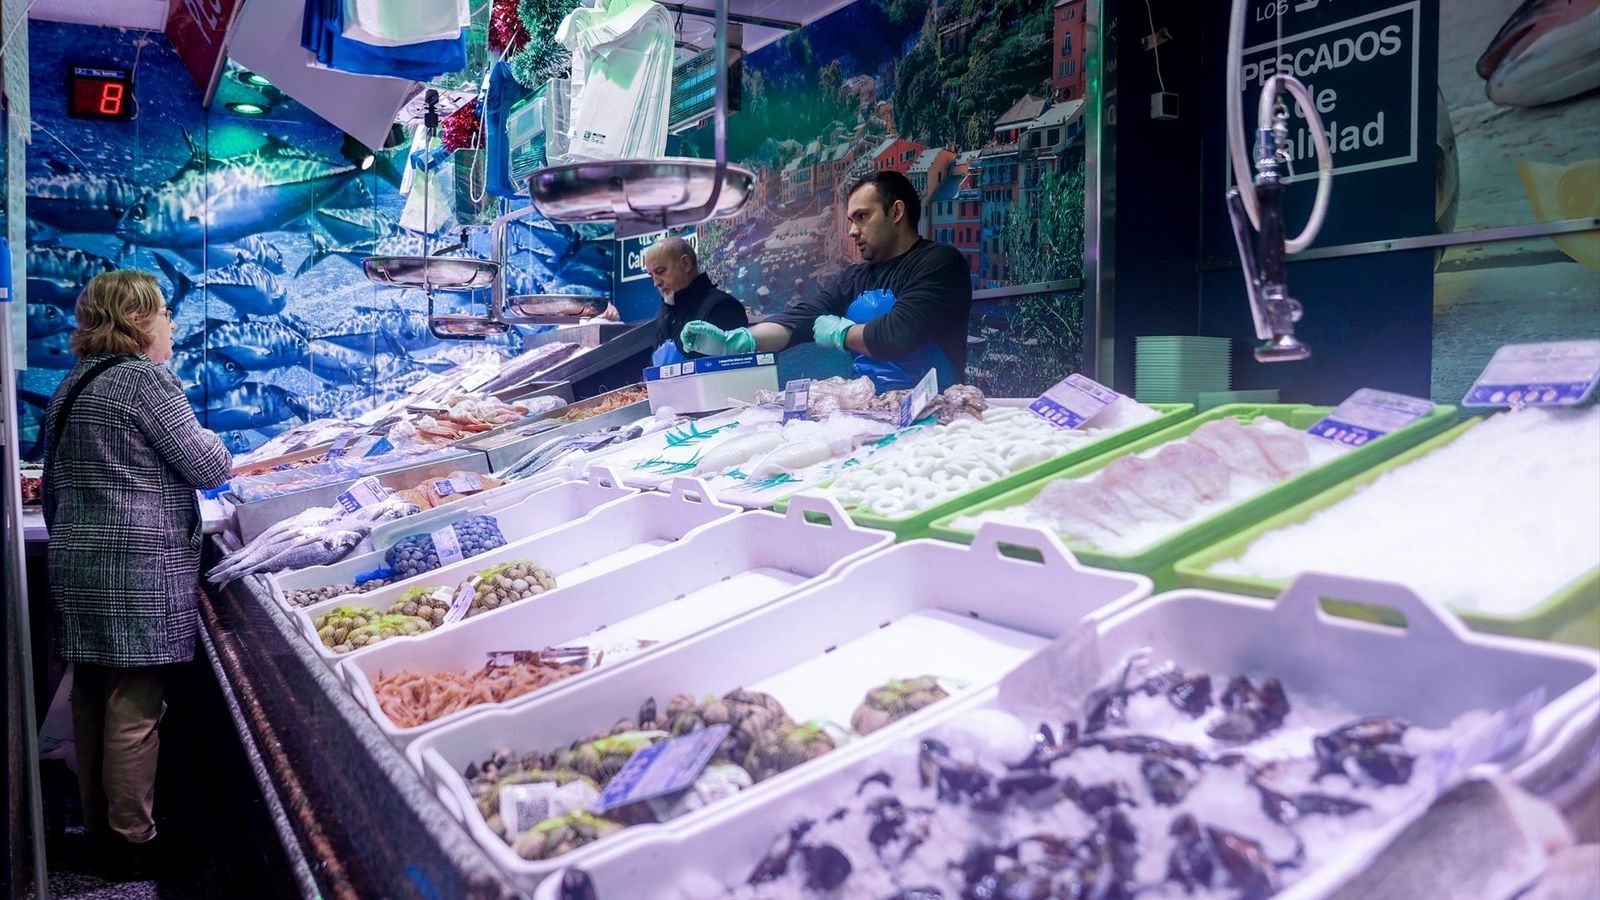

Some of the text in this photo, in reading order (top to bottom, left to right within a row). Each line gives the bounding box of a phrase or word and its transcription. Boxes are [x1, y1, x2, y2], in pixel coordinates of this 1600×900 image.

[1256, 0, 1289, 22] LOS
[1241, 25, 1402, 91] PESCADOS
[100, 83, 124, 114] 8
[1294, 84, 1338, 118] de
